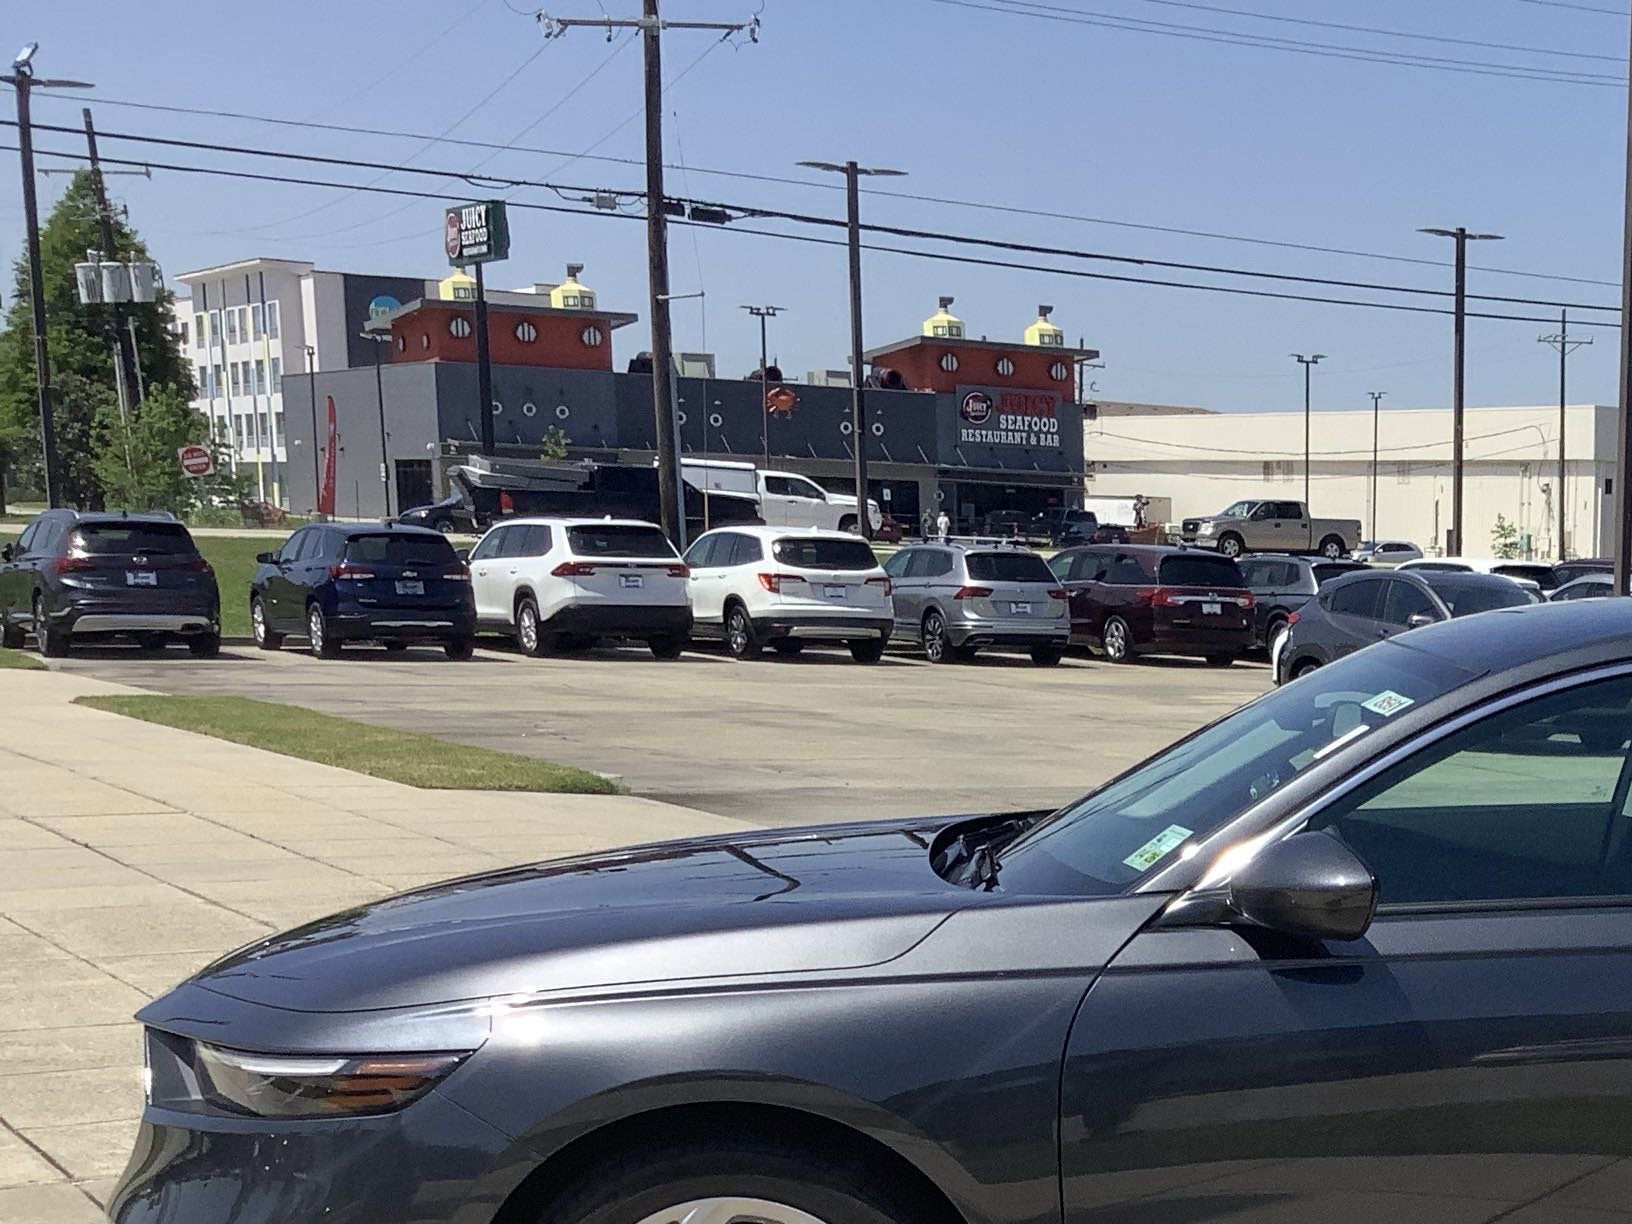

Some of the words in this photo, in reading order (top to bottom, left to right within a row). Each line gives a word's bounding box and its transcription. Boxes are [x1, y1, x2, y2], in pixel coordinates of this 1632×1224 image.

[461, 205, 486, 230] JUICY
[1000, 415, 1058, 432] SEAFOOD
[961, 429, 1027, 444] RESTAURANT
[1030, 433, 1037, 446] &
[1040, 434, 1059, 447] BAR
